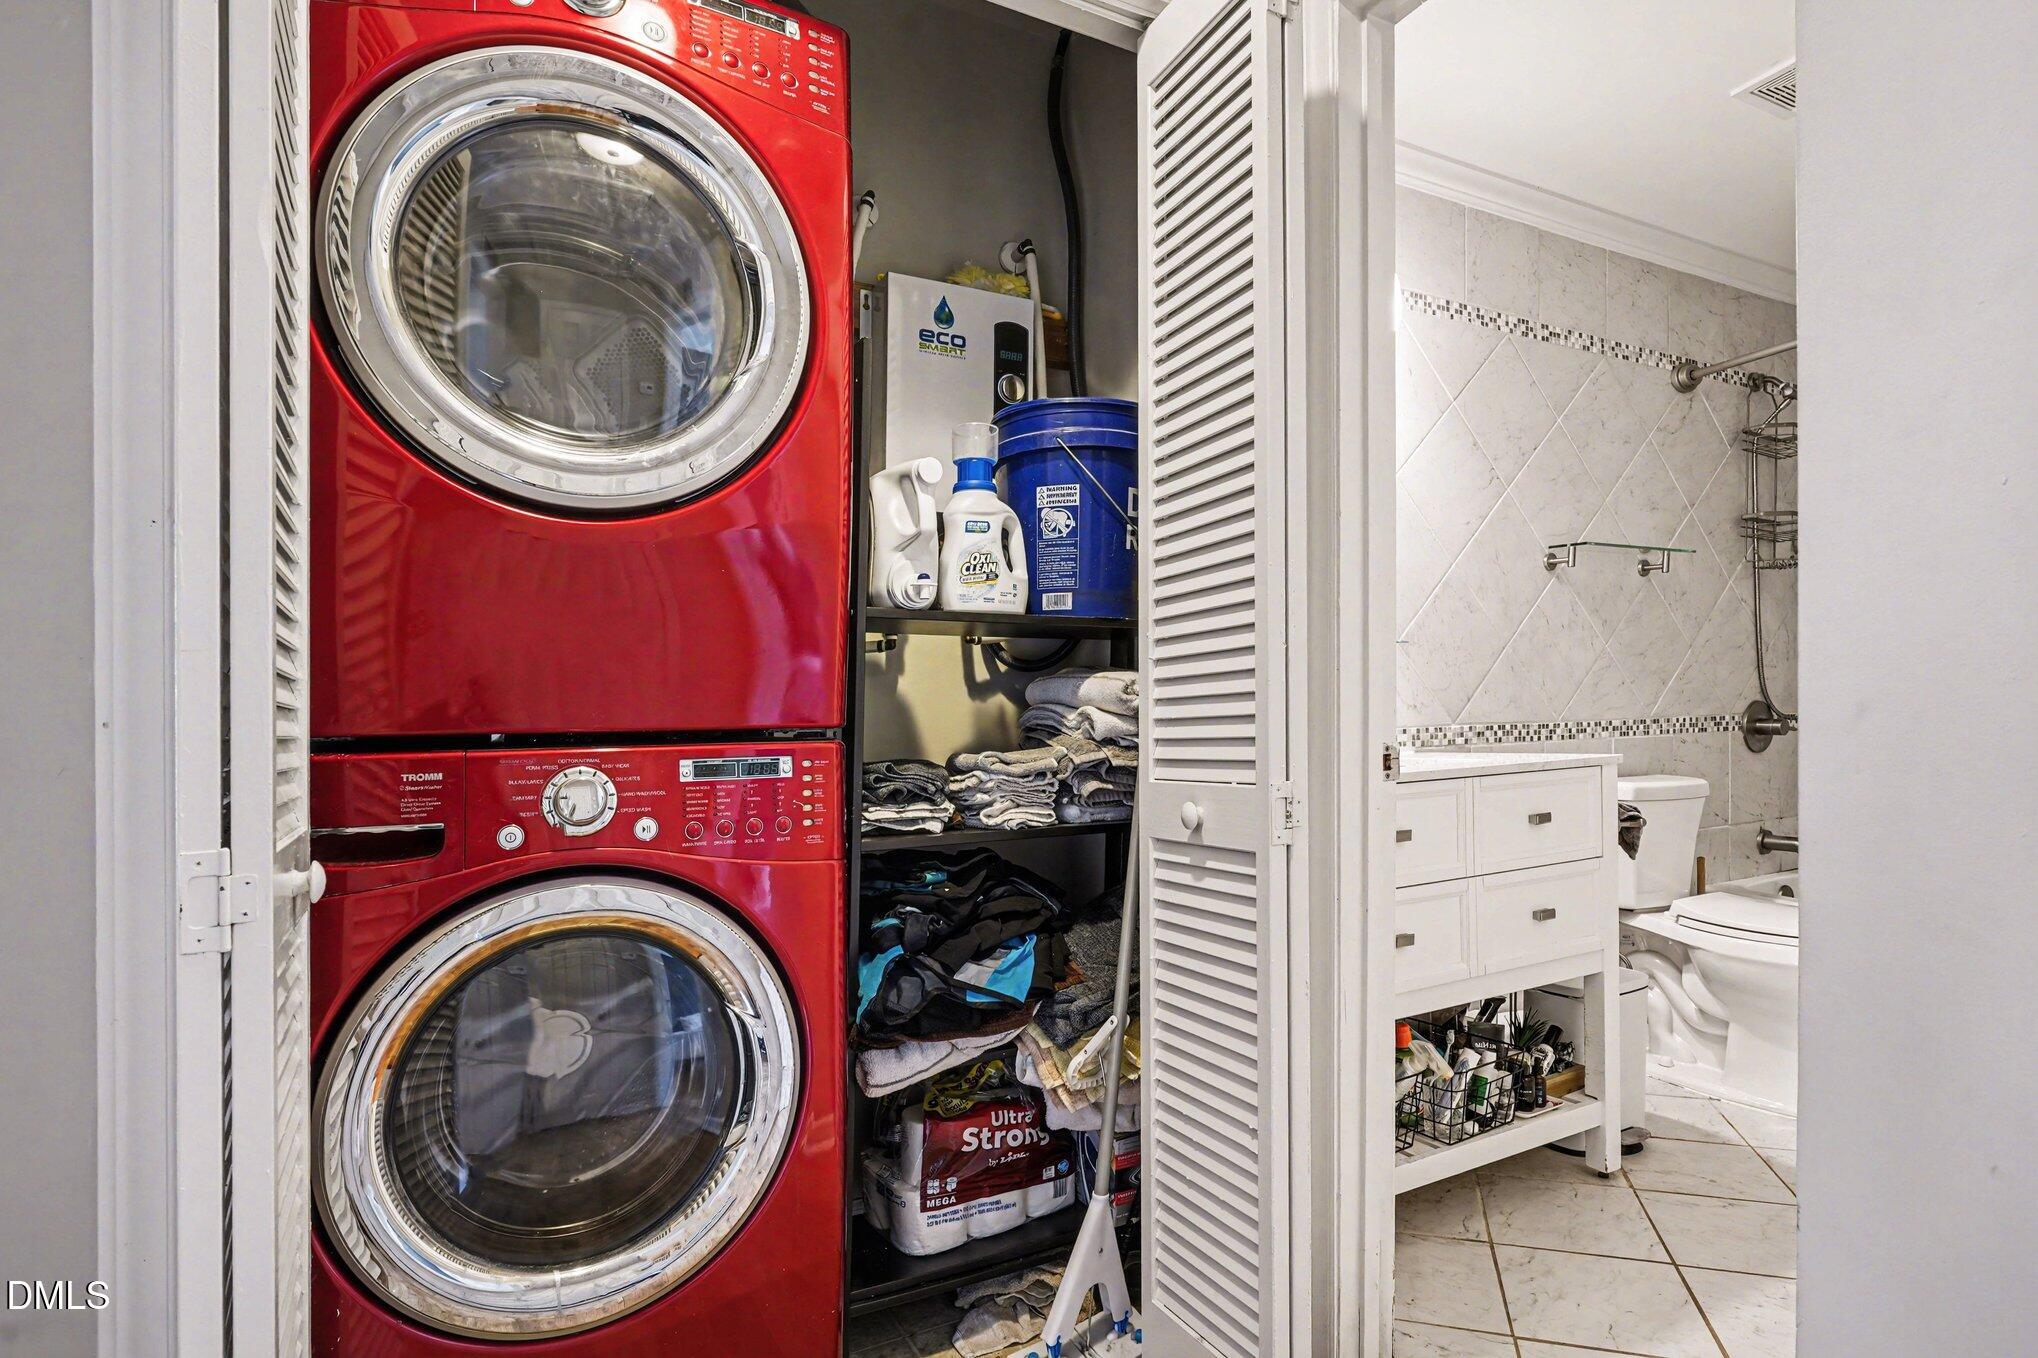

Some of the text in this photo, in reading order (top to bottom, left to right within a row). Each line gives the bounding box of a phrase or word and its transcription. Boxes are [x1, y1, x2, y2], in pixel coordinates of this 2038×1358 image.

[919, 329, 966, 348] eco
[970, 552, 991, 564] OXI
[961, 561, 998, 576] CLEAN
[401, 773, 443, 781] TROMM
[991, 1109, 1034, 1127] Ultra
[961, 1127, 1050, 1153] Strong
[926, 1195, 957, 1208] MEGA
